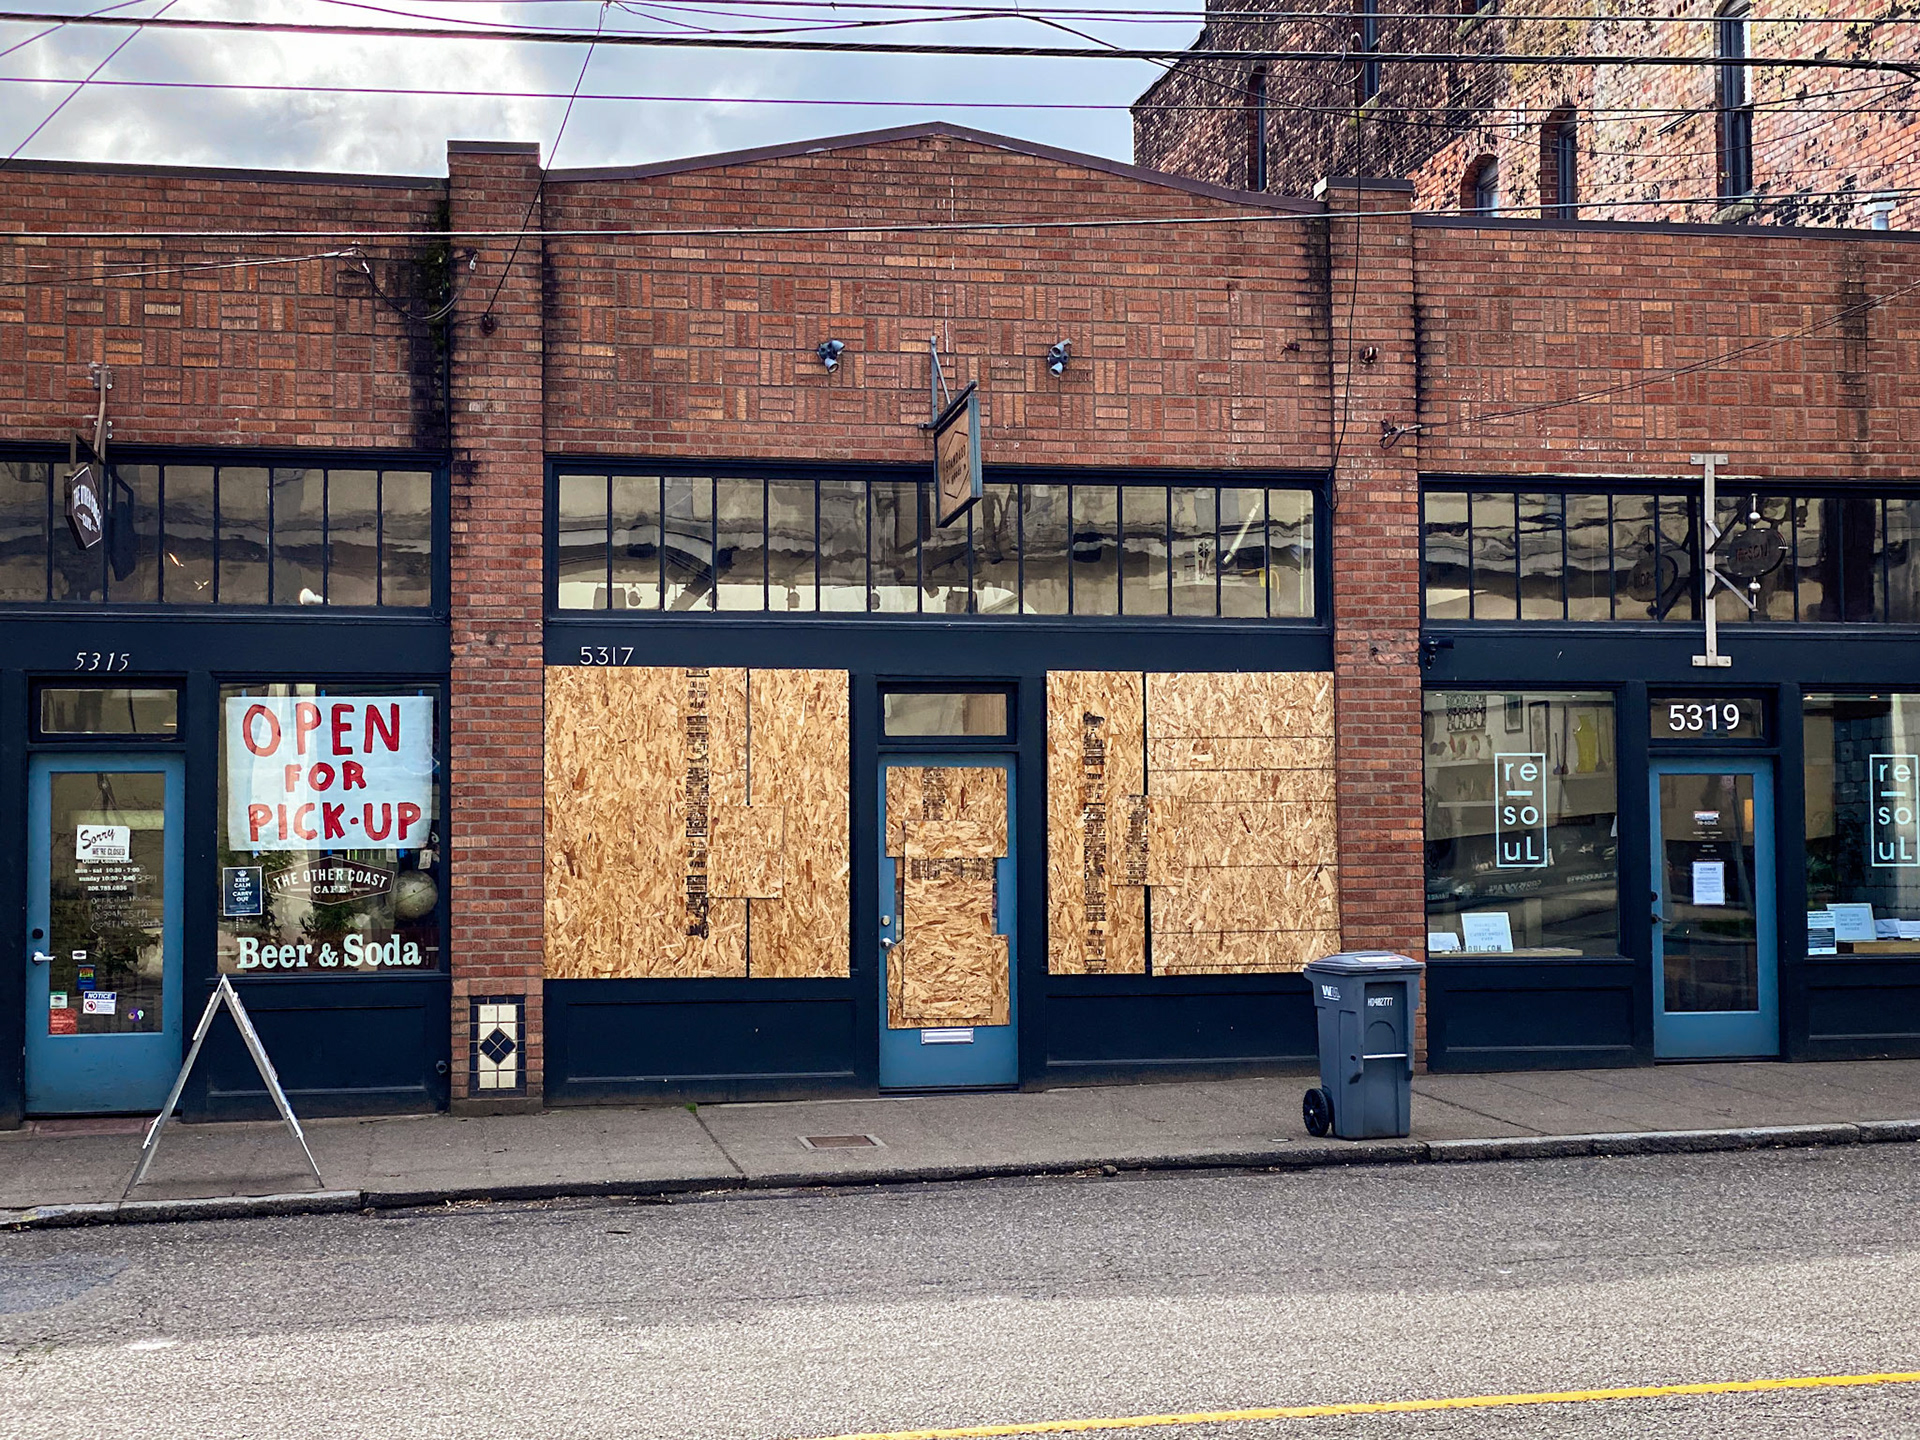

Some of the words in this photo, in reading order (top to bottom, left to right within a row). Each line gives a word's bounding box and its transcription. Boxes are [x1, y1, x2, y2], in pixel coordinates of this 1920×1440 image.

[74, 652, 130, 672] 5315
[580, 646, 634, 665] 5317
[1669, 703, 1740, 731] 5319
[242, 702, 400, 758] OPEN
[284, 760, 367, 793] FOR
[1504, 762, 1538, 782] re
[1879, 763, 1911, 783] re
[1503, 805, 1539, 826] so
[1878, 806, 1912, 826] so
[80, 828, 115, 850] Sorry
[107, 848, 126, 856] CLOSED
[273, 872, 300, 890] THE
[303, 868, 344, 883] OTHER
[347, 870, 388, 889] COAST
[313, 885, 348, 895] CAFE
[236, 936, 313, 970] Beer
[318, 942, 340, 968] &
[343, 933, 423, 967] Soda
